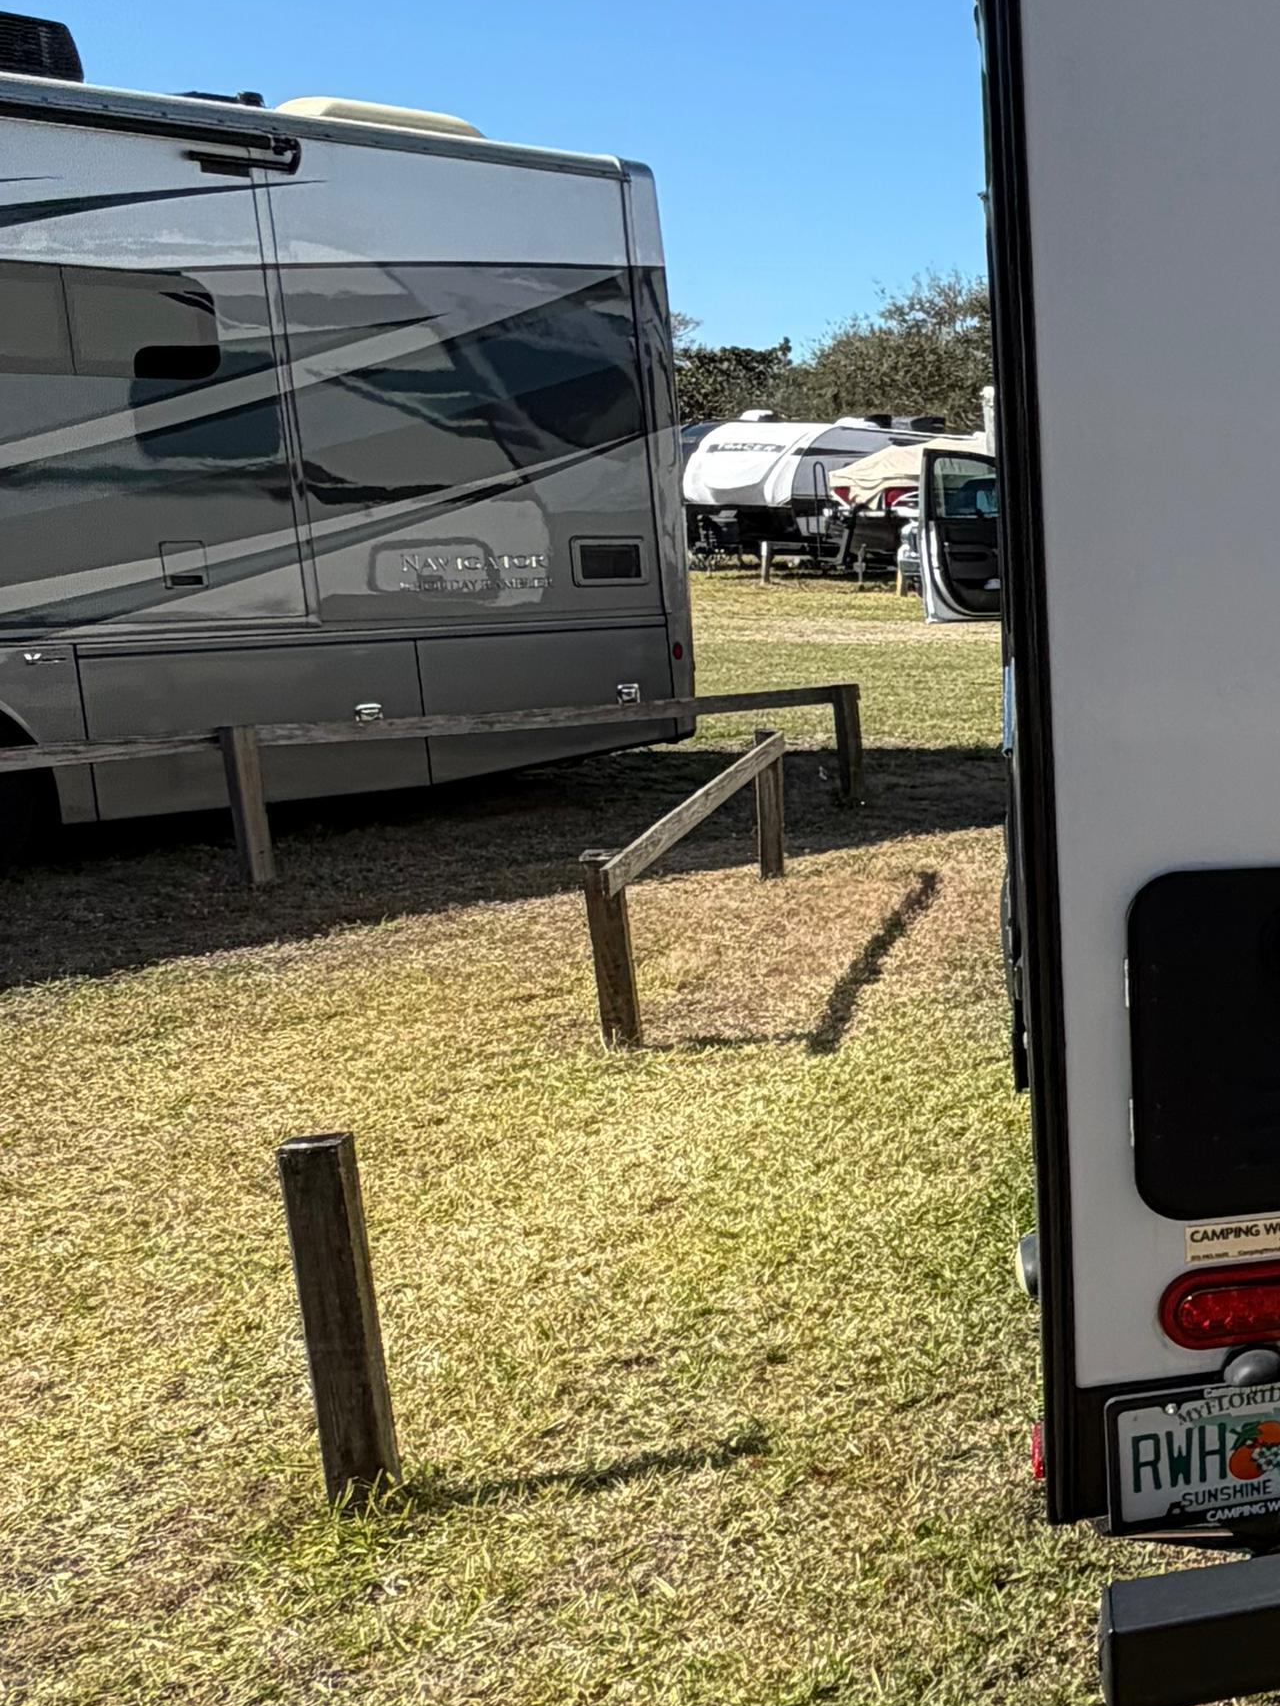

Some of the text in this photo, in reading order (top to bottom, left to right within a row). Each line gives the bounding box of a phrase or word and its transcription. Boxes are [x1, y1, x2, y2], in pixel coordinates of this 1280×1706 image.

[400, 554, 549, 572] NAVIGATOR
[1190, 1224, 1261, 1243] CAMPING
[1131, 1421, 1227, 1493] RWH
[1181, 1479, 1272, 1507] SUNSHINE
[1206, 1503, 1266, 1522] CAMPING
